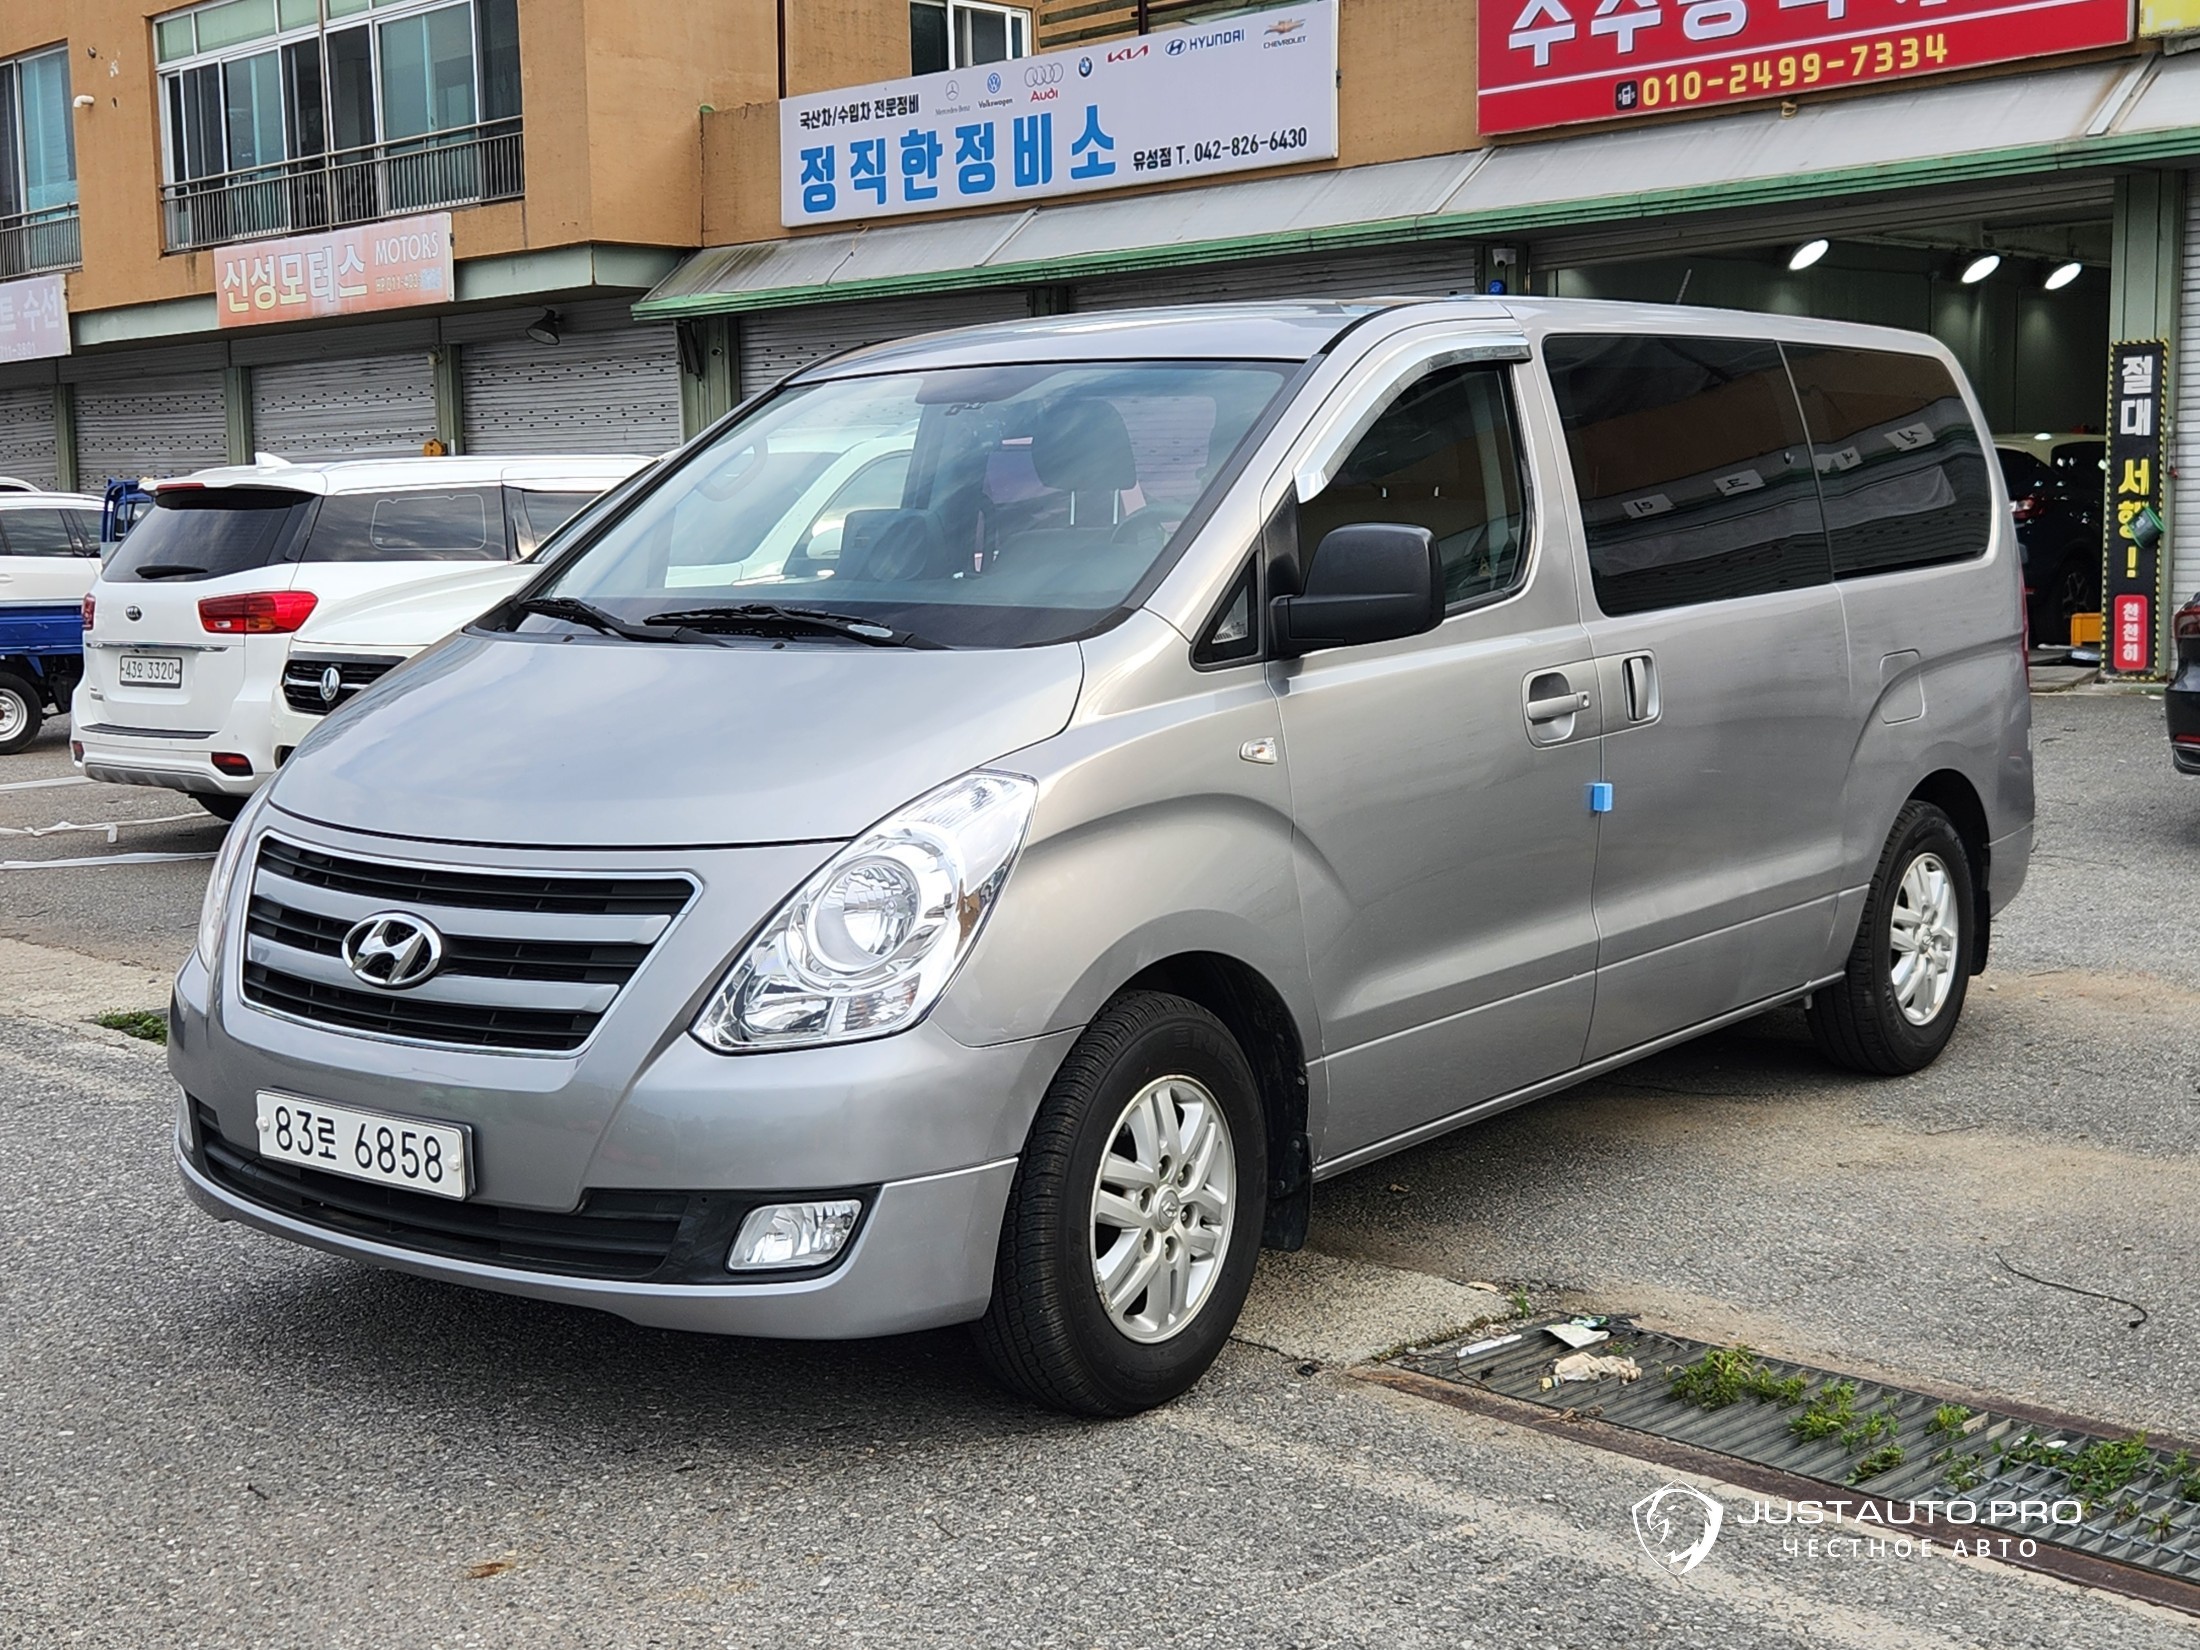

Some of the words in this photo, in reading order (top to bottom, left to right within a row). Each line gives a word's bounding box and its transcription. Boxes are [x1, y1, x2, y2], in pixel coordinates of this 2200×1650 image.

[1107, 44, 1149, 63] KIA
[1189, 29, 1245, 50] HYUNDAI
[1263, 36, 1306, 49] CHEVROLET
[1643, 33, 1948, 107] 010-2499-7334
[799, 101, 871, 130] 국산차/수입차
[874, 93, 919, 120] 전문정비
[1029, 87, 1059, 103] Audi
[799, 104, 1117, 214] 정직한정비소
[1133, 147, 1172, 171] 유성점
[1176, 145, 1190, 165] T.
[1194, 127, 1307, 162] 042-826-6430
[375, 231, 439, 266] MOTORS
[223, 245, 368, 313] 신성모터스
[2119, 355, 2153, 437] 절대
[147, 662, 175, 680] 3320
[275, 1105, 337, 1161] 83로
[355, 1122, 443, 1184] 6858
